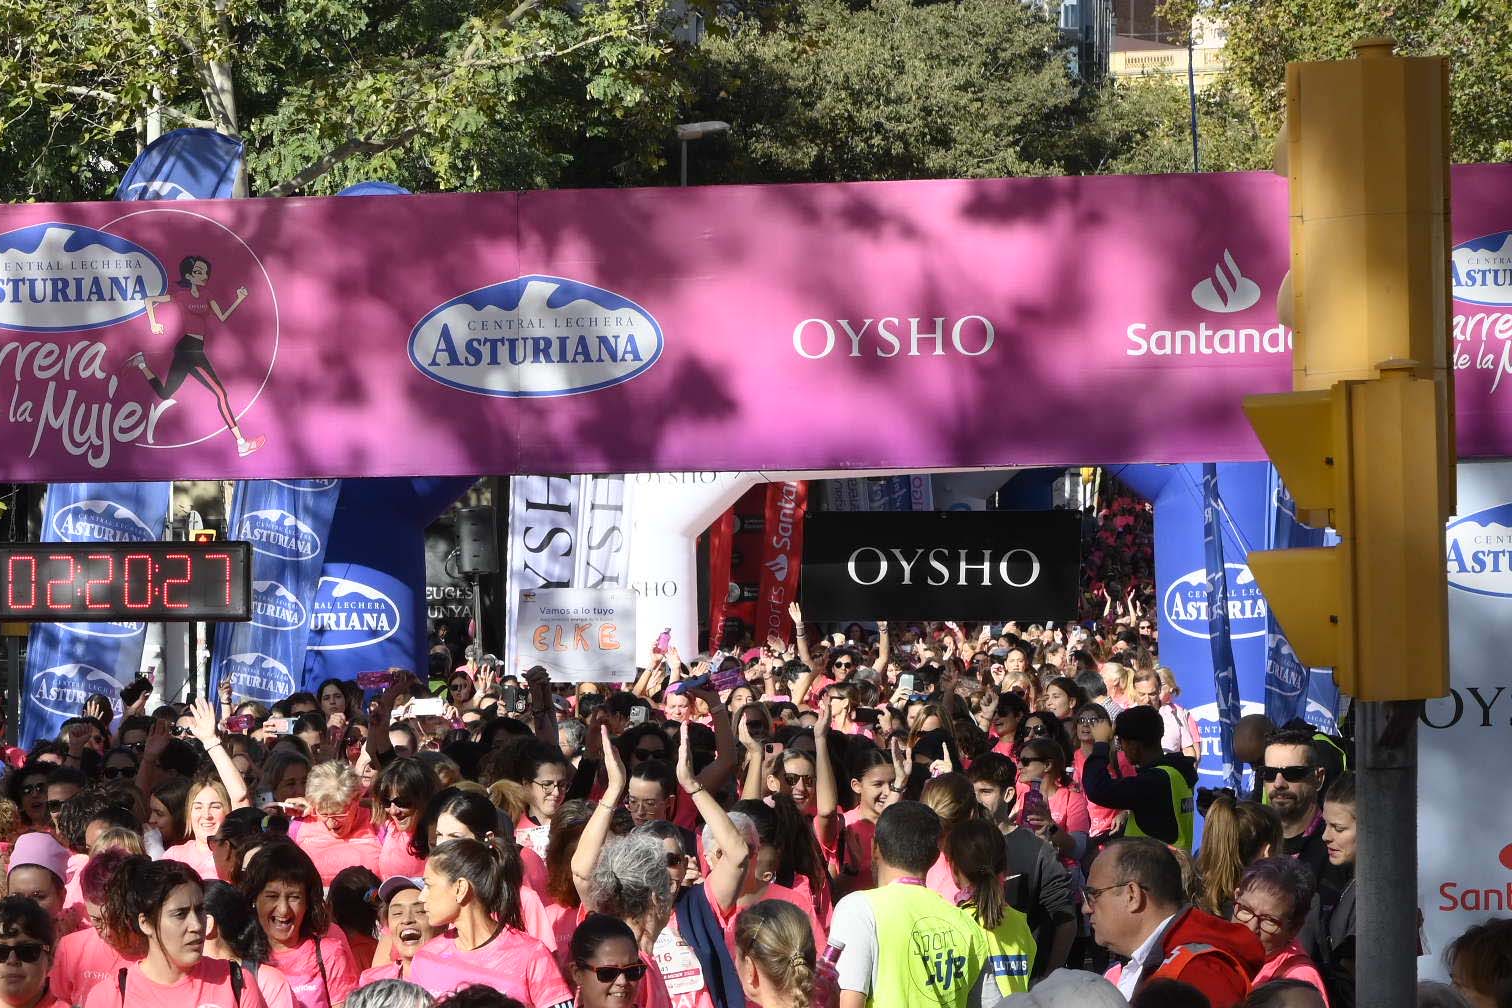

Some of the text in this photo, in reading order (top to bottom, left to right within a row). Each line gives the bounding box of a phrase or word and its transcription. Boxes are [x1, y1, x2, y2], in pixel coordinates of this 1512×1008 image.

[70, 258, 143, 271] LECHERA
[467, 315, 635, 331] CENTRAL LECHERA
[792, 316, 995, 360] OYSHO
[428, 322, 644, 367] ASTURIANA
[1126, 322, 1294, 356] Santand
[1476, 342, 1495, 370] la
[9, 386, 33, 424] la
[29, 373, 178, 468] Mujer
[8, 554, 231, 608] 02:20:27
[847, 547, 1041, 587] OYSHO
[338, 601, 385, 609] LECHERA
[593, 607, 615, 617] tuyo
[533, 623, 621, 651] ELKE
[913, 929, 957, 956] Sport
[922, 949, 967, 990] Life
